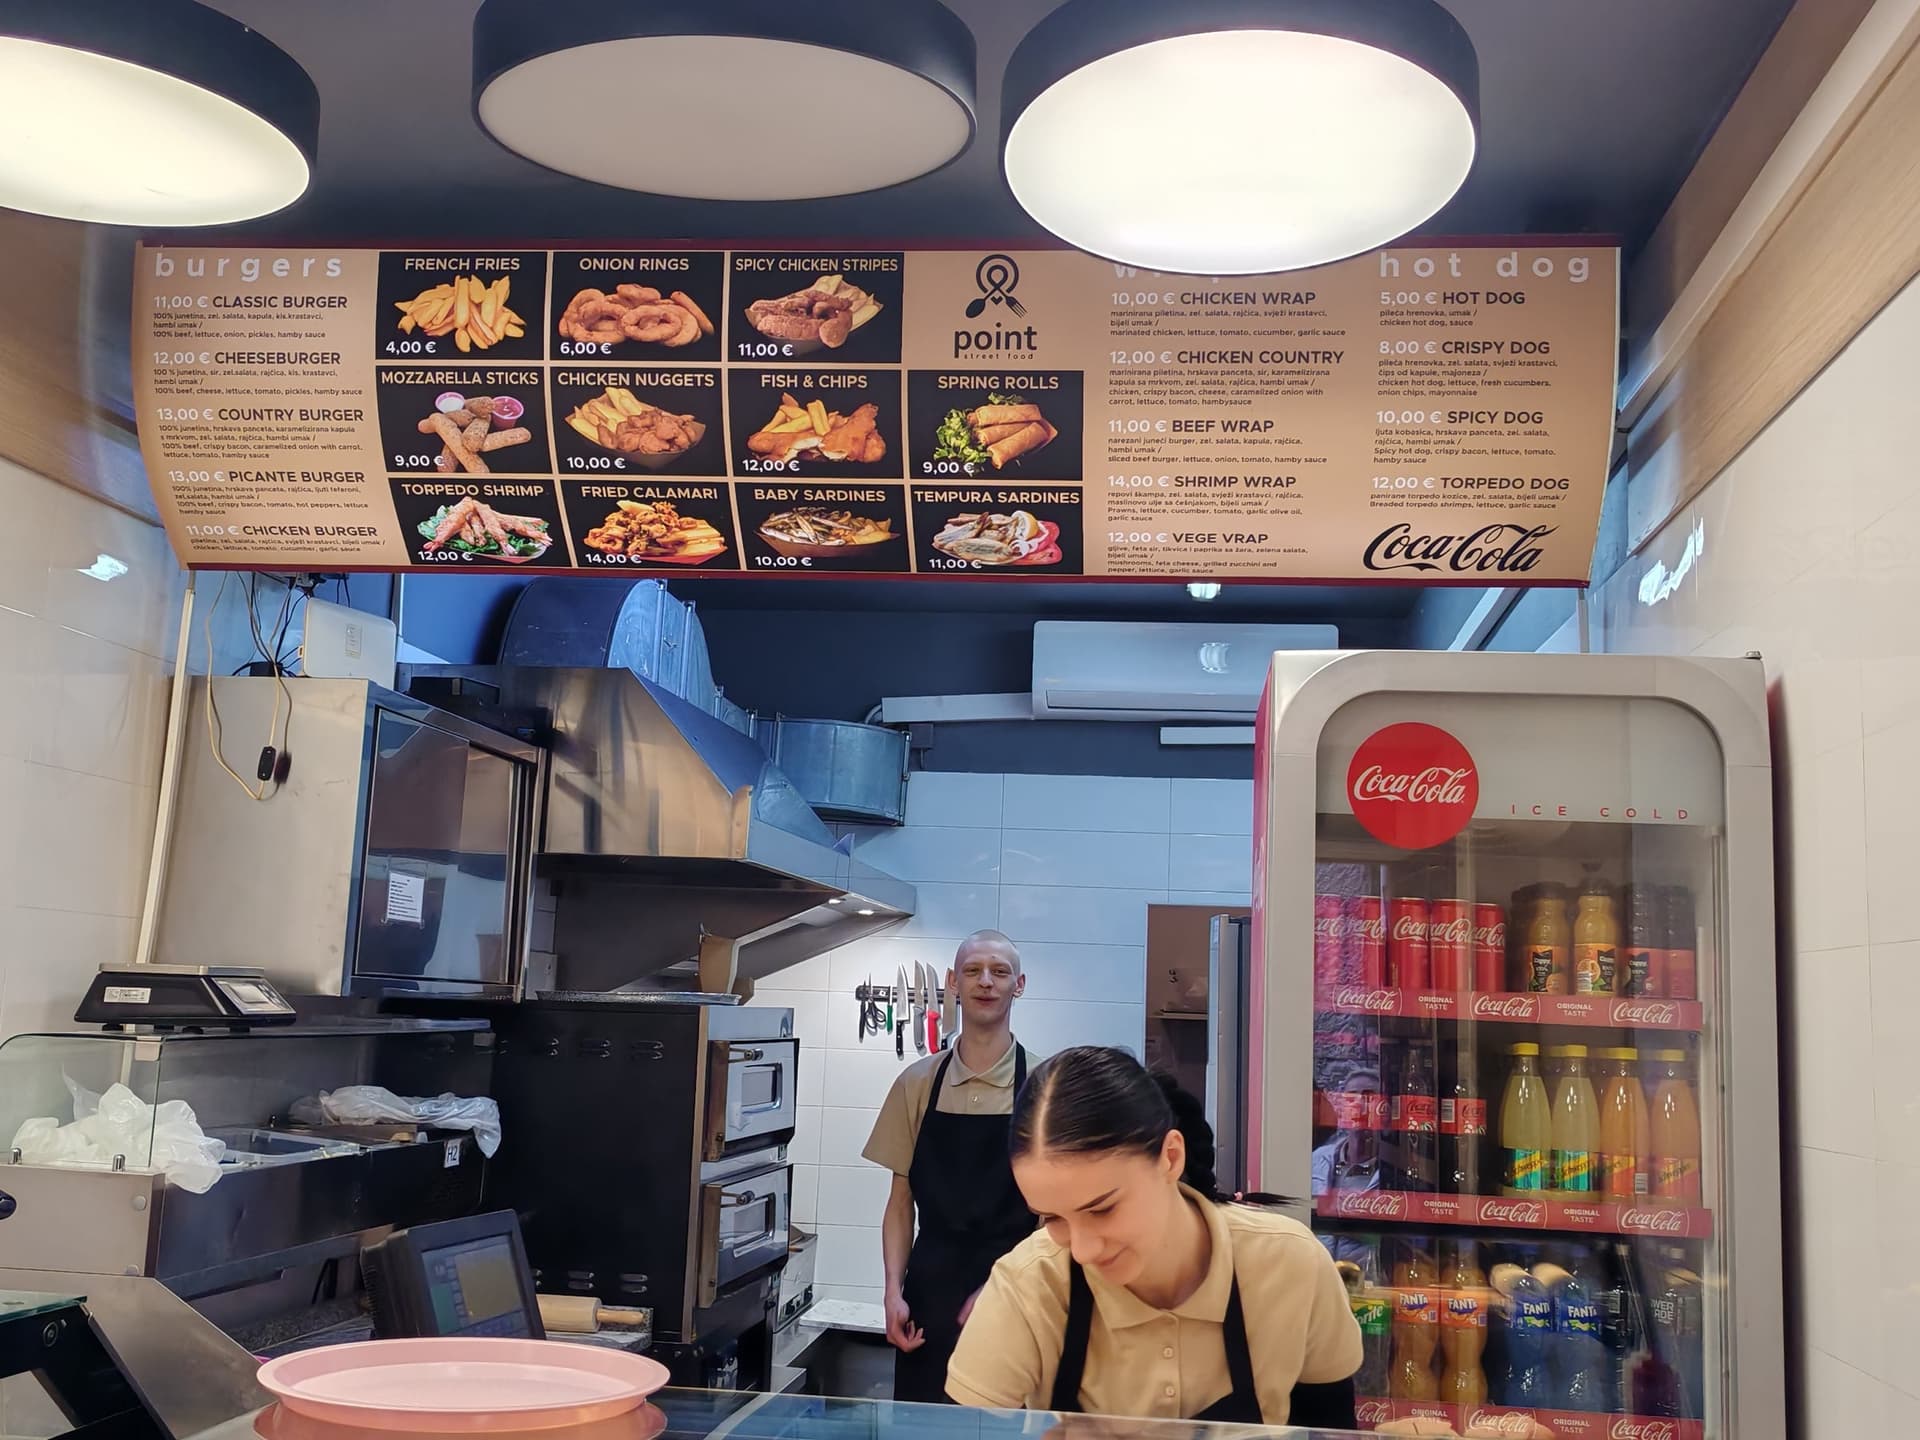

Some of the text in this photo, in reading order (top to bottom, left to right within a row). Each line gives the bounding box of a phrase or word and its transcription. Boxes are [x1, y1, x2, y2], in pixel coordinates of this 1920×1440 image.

[155, 253, 342, 282] burgers
[405, 258, 520, 270] FRENCH FRIES
[580, 258, 689, 271] ONION RINGS
[735, 259, 898, 271] SPICY CHICKEN STRIPES
[1380, 252, 1589, 283] hot dog
[154, 296, 347, 308] 11,00 € CLASSIC BURGER
[1112, 293, 1316, 306] 10,00 € CHICKEN WRAP
[1381, 292, 1525, 306] 5,00 € HOT DOG
[1429, 319, 1448, 327] dog,
[954, 322, 1037, 358] point
[386, 341, 436, 354] 4,00 €
[560, 342, 611, 355] 6,00 €
[738, 344, 793, 356] 11,00 €
[1379, 341, 1549, 355] 8,00 € CRISPY DOG
[154, 352, 340, 365] 12,00 € CHEESEBURGER
[1110, 351, 1344, 365] 12,00 € CHICKEN COUNTRY
[381, 372, 538, 385] MOZZARELLA STICKS
[558, 373, 714, 387] CHICKEN NUGGETS
[761, 375, 867, 388] FISH & CHIPS
[938, 376, 1058, 389] SPRING ROLLS
[1403, 389, 1426, 397] chips,
[1429, 389, 1477, 397] mayonnaise
[157, 408, 363, 421] 13,00 € COUNTRY BURGER
[1377, 411, 1543, 425] 10,00 € SPICY DOG
[1108, 420, 1273, 434] 11,00 € BEEF WRAP
[395, 455, 445, 468] 9,00 €
[567, 456, 626, 469] 10,00 €
[743, 459, 800, 472] 12,00 €
[923, 462, 974, 474] 9,00 €
[169, 471, 364, 482] 13,00 € PICANTE BURGER
[1108, 476, 1296, 489] 14,00 € SHRIMP WRAP
[401, 484, 544, 496] TORPEDO SHRIMP
[1372, 477, 1569, 490] 12,00 € TORPEDO DOG
[581, 487, 718, 499] FRIED CALAMARI
[754, 489, 885, 501] BABY SARDINES
[914, 491, 1079, 504] TEMPURA SARDINES
[186, 526, 377, 536] 11,00 € CHICKEN BURGER
[1108, 533, 1268, 544] 12,00 € VEGE VRAP
[1363, 523, 1559, 571] Coca-Cola
[418, 551, 473, 562] 12,00 €
[586, 553, 642, 564] 14,00 €
[755, 557, 812, 567] 10,00 €
[929, 559, 982, 569] 11,00 €
[1354, 765, 1473, 804] Coca-Cola
[1511, 805, 1688, 820] ICE COLD
[1336, 987, 1398, 1011] Coca-Cola
[1418, 996, 1454, 1004] ORIGINAL
[1474, 996, 1537, 1018] Coca-Cola
[1557, 1002, 1592, 1010] ORIGINAL
[1563, 1009, 1586, 1017] TASTE
[1614, 1002, 1677, 1025] Coca-Cola
[1341, 1193, 1405, 1216] Coca-Cola
[1424, 1200, 1459, 1208] ORIGINAL
[1480, 1201, 1544, 1222] Coca-Cola
[1564, 1208, 1600, 1216] ORIGINAL
[1621, 1208, 1687, 1230] Coca-Cola
[1400, 1294, 1428, 1305] FANTA
[1412, 1409, 1447, 1417] ORIGINAL
[1469, 1409, 1530, 1433] Coca-Cola
[1553, 1418, 1590, 1427] ORIGINAL
